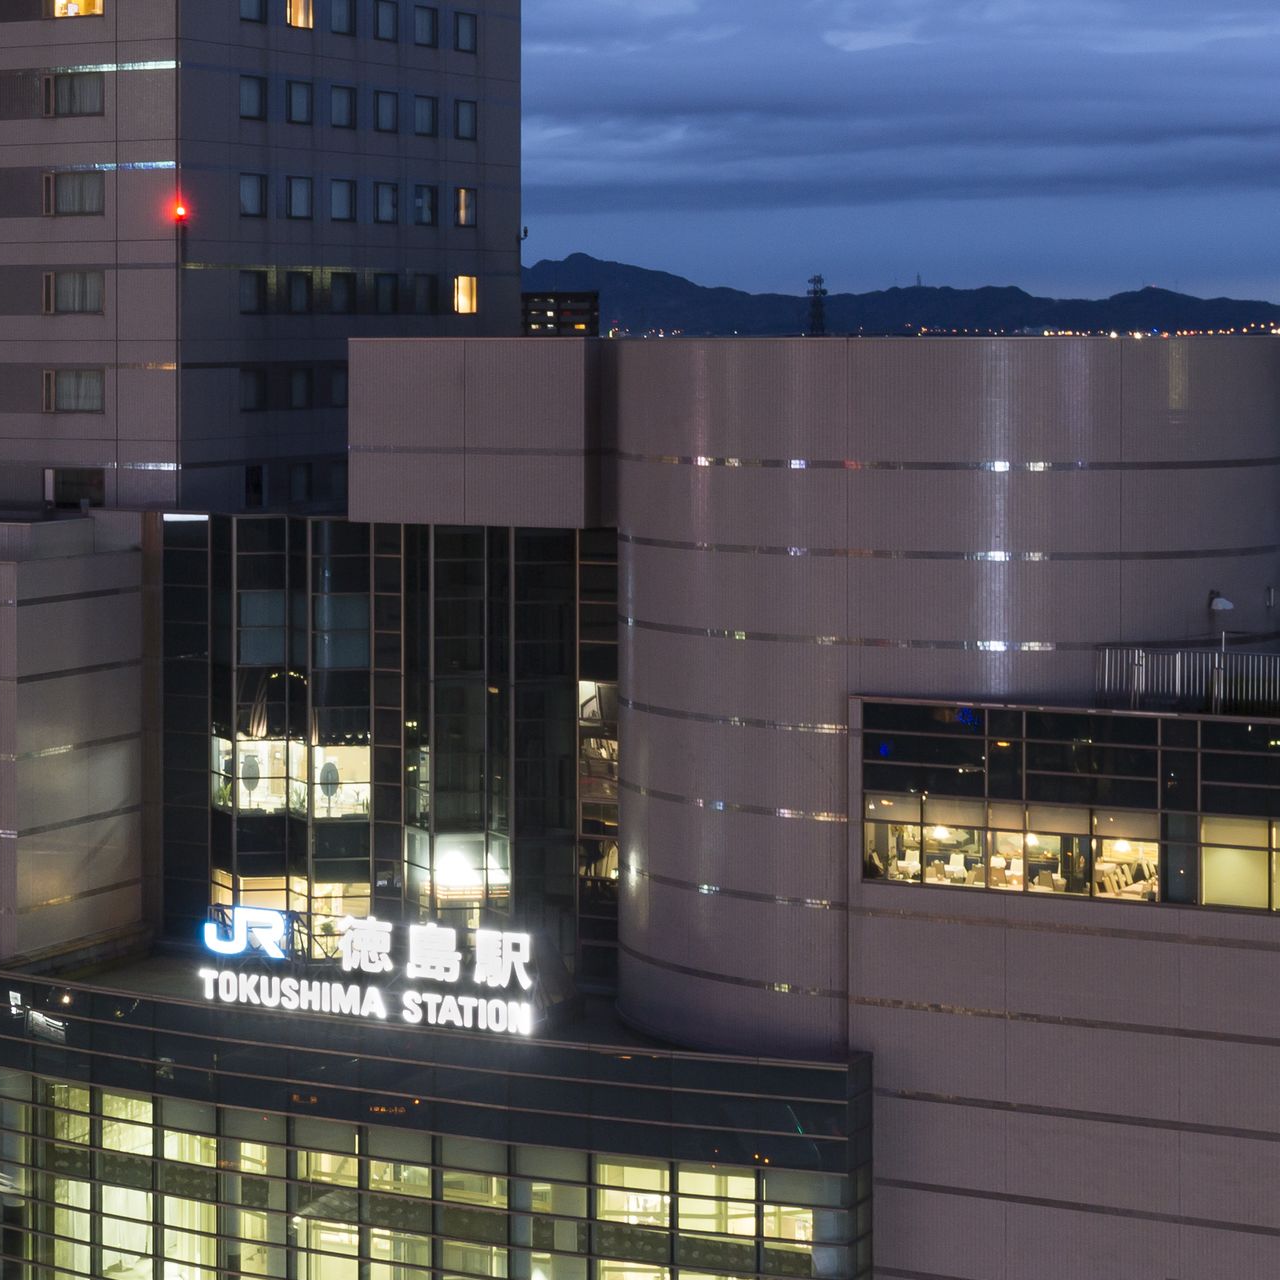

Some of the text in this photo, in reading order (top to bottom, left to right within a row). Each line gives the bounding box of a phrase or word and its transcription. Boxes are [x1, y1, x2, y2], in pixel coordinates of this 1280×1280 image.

[203, 907, 533, 991] JR 徳島駅
[198, 967, 533, 1036] TOKUSHIMA STATION
